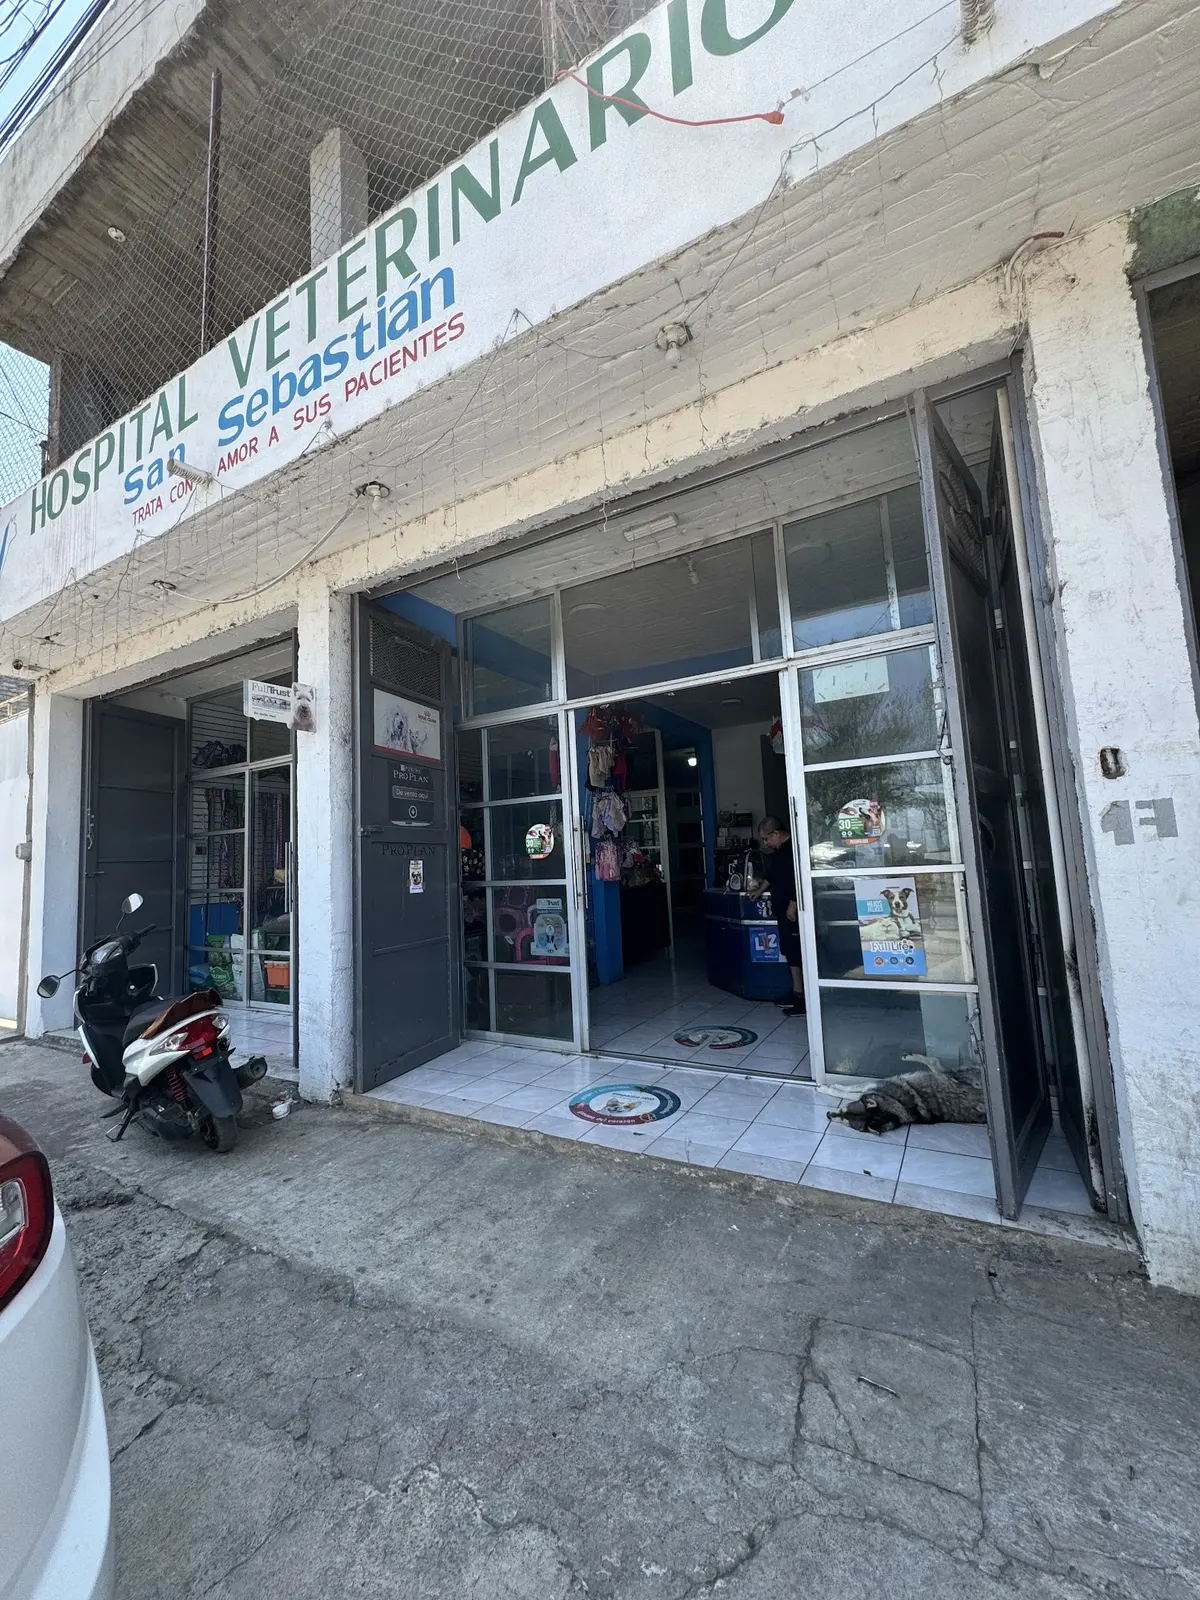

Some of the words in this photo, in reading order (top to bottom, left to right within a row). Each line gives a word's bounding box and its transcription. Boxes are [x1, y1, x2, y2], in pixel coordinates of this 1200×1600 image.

[31, 374, 199, 535] HOSPITAL
[228, 0, 794, 390] VETERINARIO
[218, 266, 456, 447] Sebastián
[132, 496, 163, 527] TRATA
[169, 476, 193, 504] CON
[217, 436, 259, 476] AMOR
[268, 426, 279, 447] A
[293, 393, 332, 431] SUS
[345, 312, 466, 402] PACIENTES
[251, 682, 291, 698] FullTrust
[838, 819, 851, 830] 30
